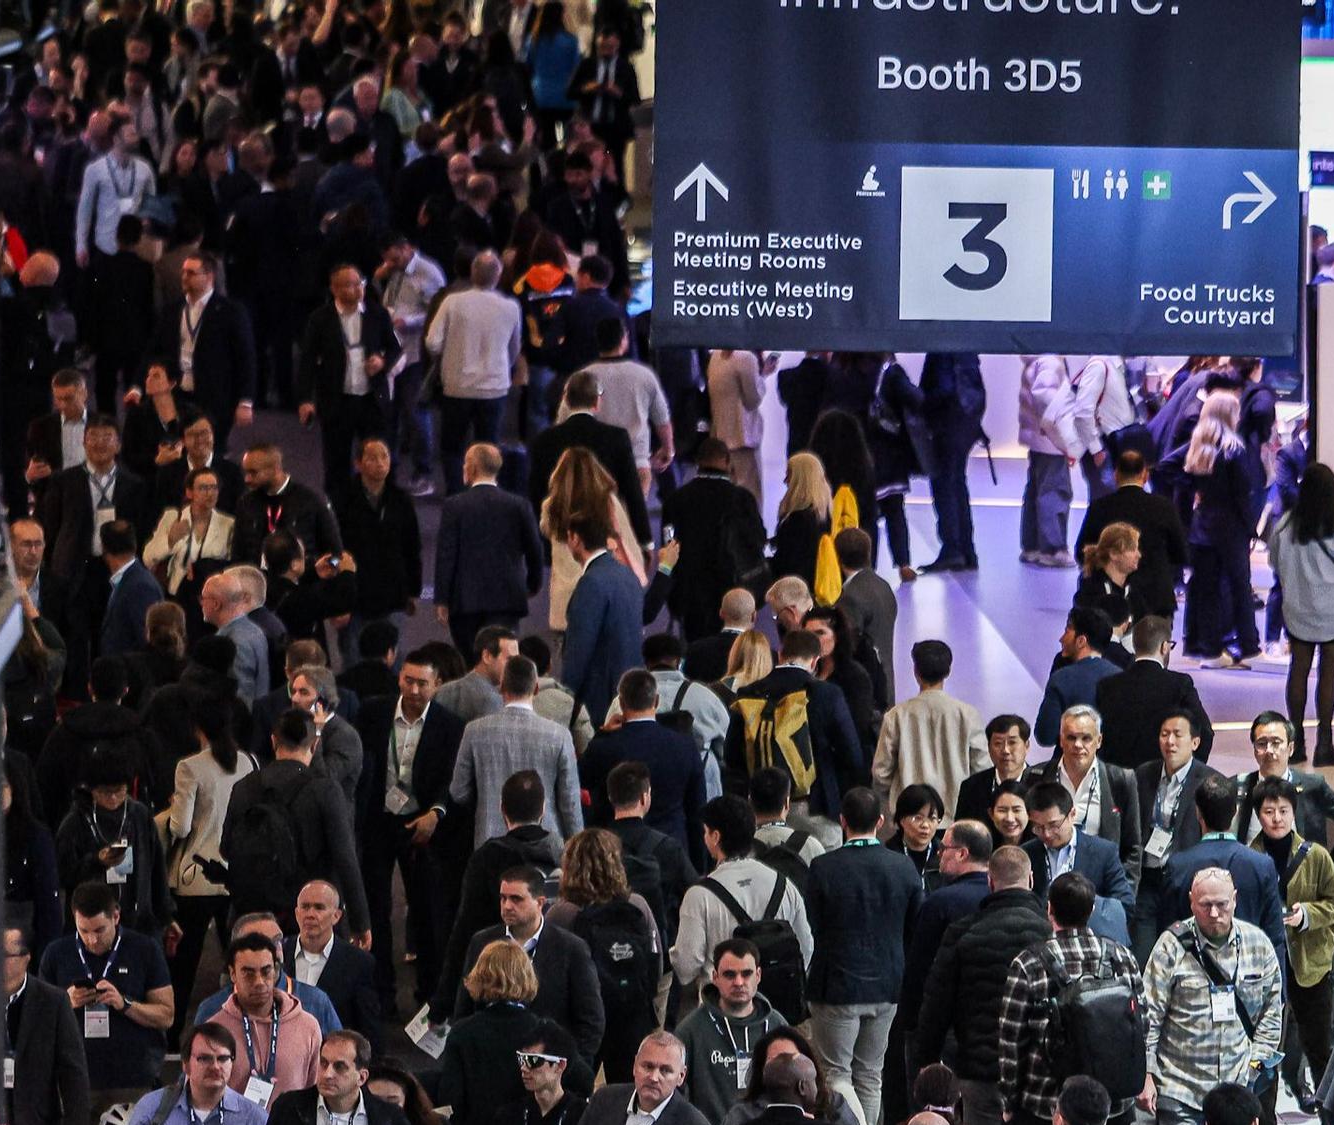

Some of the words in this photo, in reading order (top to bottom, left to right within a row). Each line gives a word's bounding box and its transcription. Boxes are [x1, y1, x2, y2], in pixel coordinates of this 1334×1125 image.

[877, 56, 990, 92] Booth
[1003, 58, 1082, 93] 3D5
[673, 231, 760, 249] Premium
[767, 232, 863, 250] Executive
[942, 201, 1008, 291] 3
[673, 251, 752, 271] Meeting
[759, 252, 827, 270] Rooms
[673, 279, 768, 298] Executive
[774, 281, 854, 301] Meeting
[1140, 283, 1197, 302] Food
[1204, 284, 1275, 303] Trucks
[673, 300, 740, 317] Rooms
[746, 301, 814, 320] (West)
[1164, 306, 1275, 328] Courtyard
